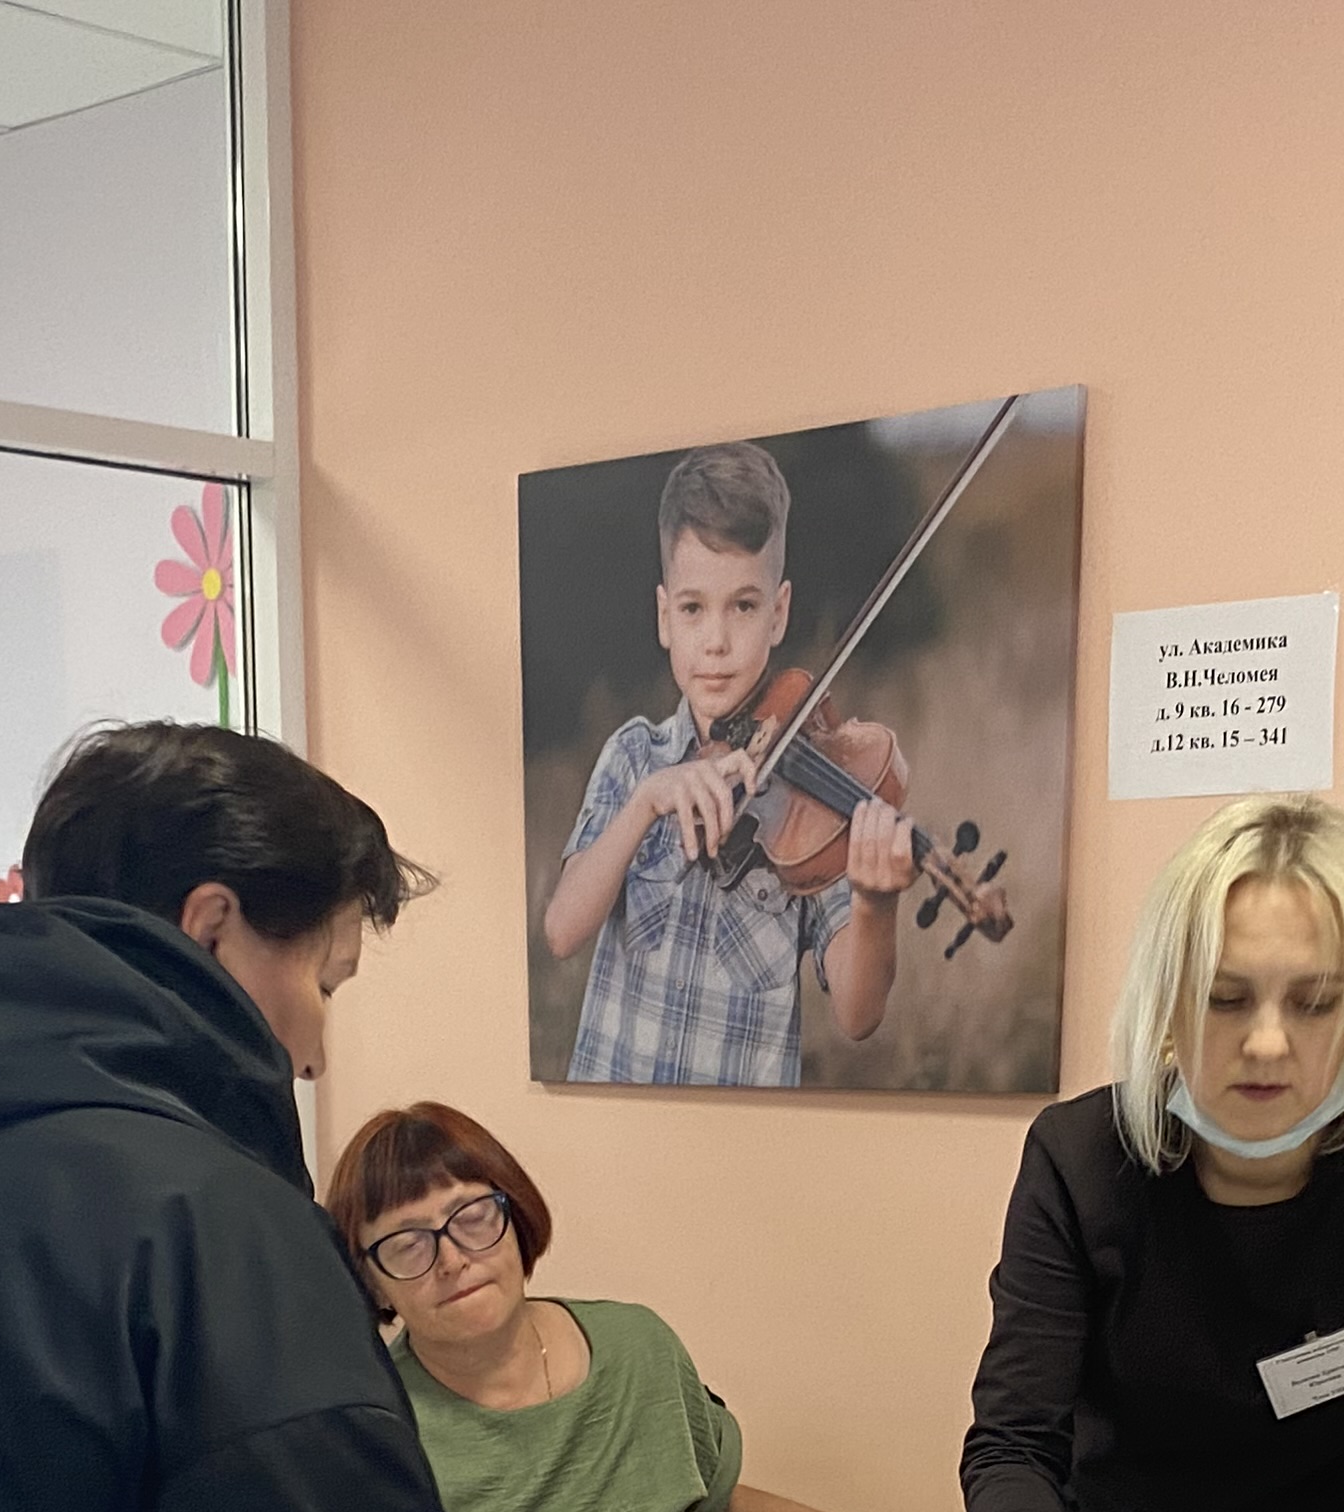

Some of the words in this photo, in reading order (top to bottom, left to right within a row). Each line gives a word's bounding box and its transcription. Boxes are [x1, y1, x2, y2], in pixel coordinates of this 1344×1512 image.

[1158, 644, 1184, 663] ул.
[1190, 635, 1287, 655] Академика
[1166, 668, 1278, 689] В.Н.Челомея
[1155, 708, 1170, 722] д.
[1175, 702, 1185, 719] 9
[1190, 705, 1215, 719] кв.
[1222, 698, 1240, 717] 16
[1256, 695, 1286, 714] 279
[1150, 733, 1184, 753] д.12
[1189, 737, 1215, 750] кв.
[1222, 730, 1240, 748] 15
[1259, 727, 1287, 746] 341
